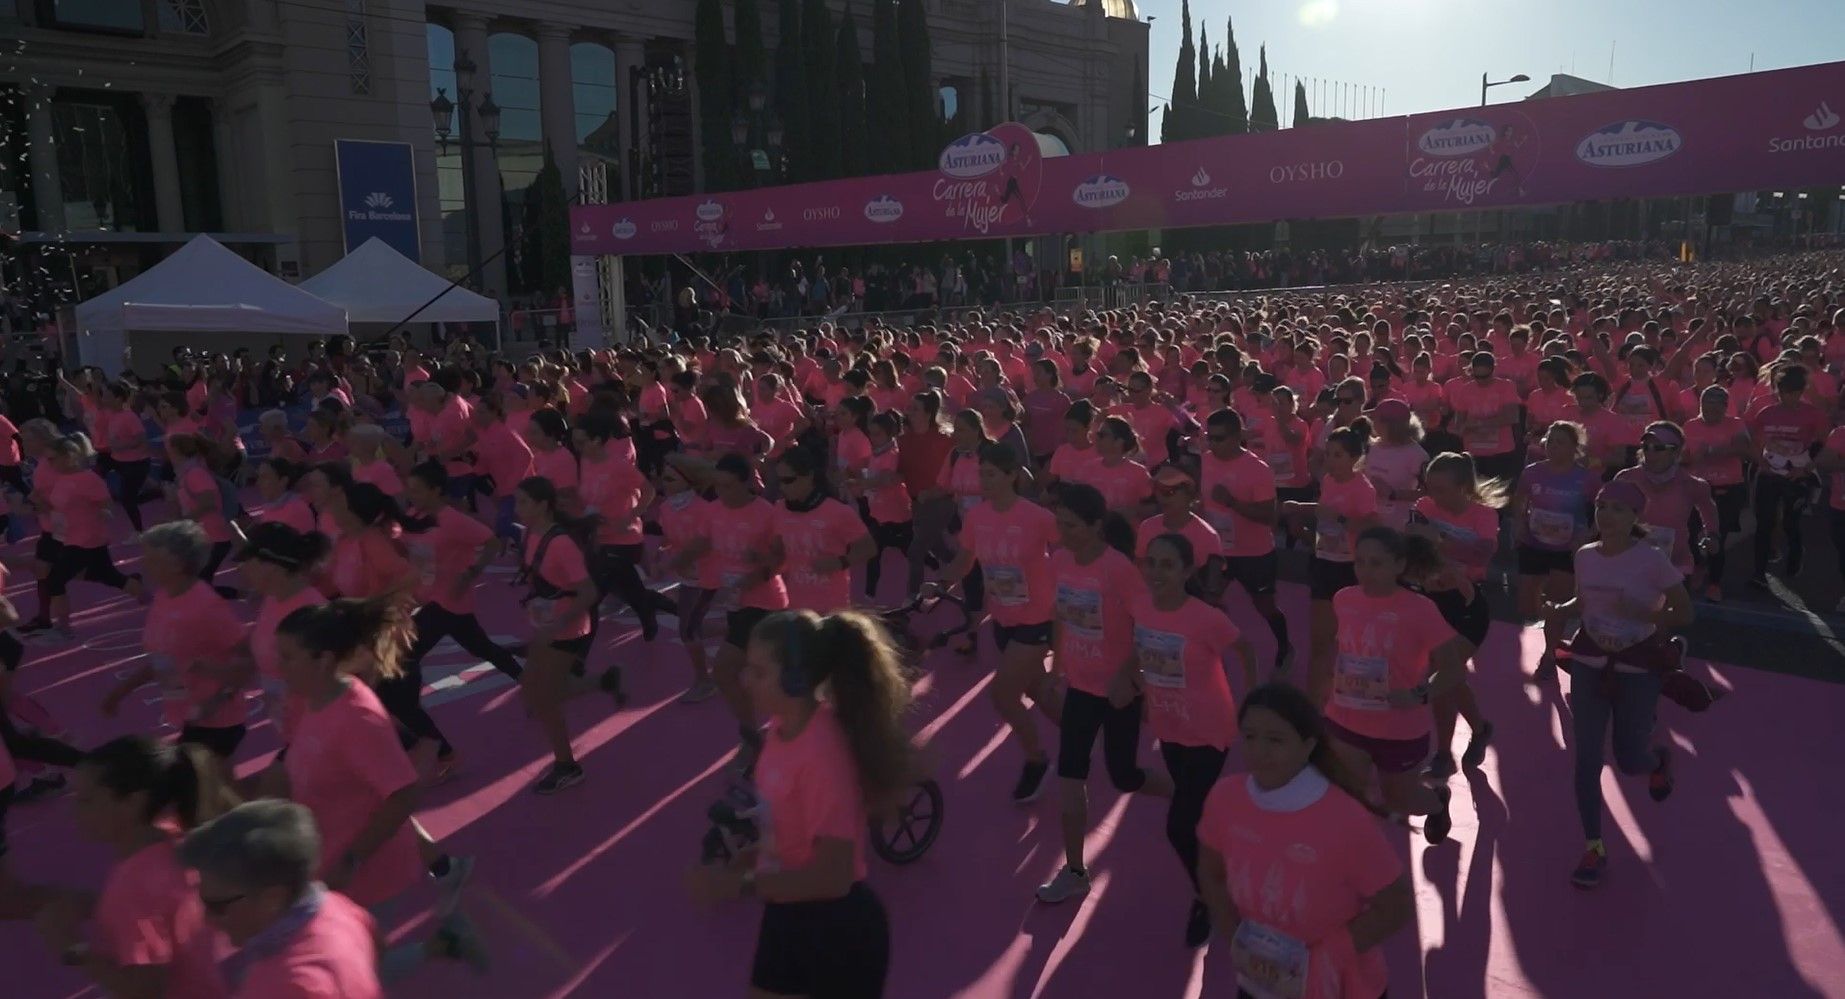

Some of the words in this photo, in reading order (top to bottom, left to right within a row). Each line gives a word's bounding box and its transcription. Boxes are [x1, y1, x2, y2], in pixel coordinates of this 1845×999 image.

[1423, 133, 1492, 150] ASTURIANA
[1582, 138, 1675, 158] ASTURIANA
[944, 152, 1002, 170] ASTURIANA
[1409, 157, 1476, 178] Carrera
[1270, 160, 1344, 183] OYSHO
[933, 178, 987, 201] Carrera
[1175, 187, 1228, 202] Santander
[1445, 173, 1500, 204] Mujer
[803, 206, 841, 221] OYSHO
[964, 196, 1008, 234] Mujer
